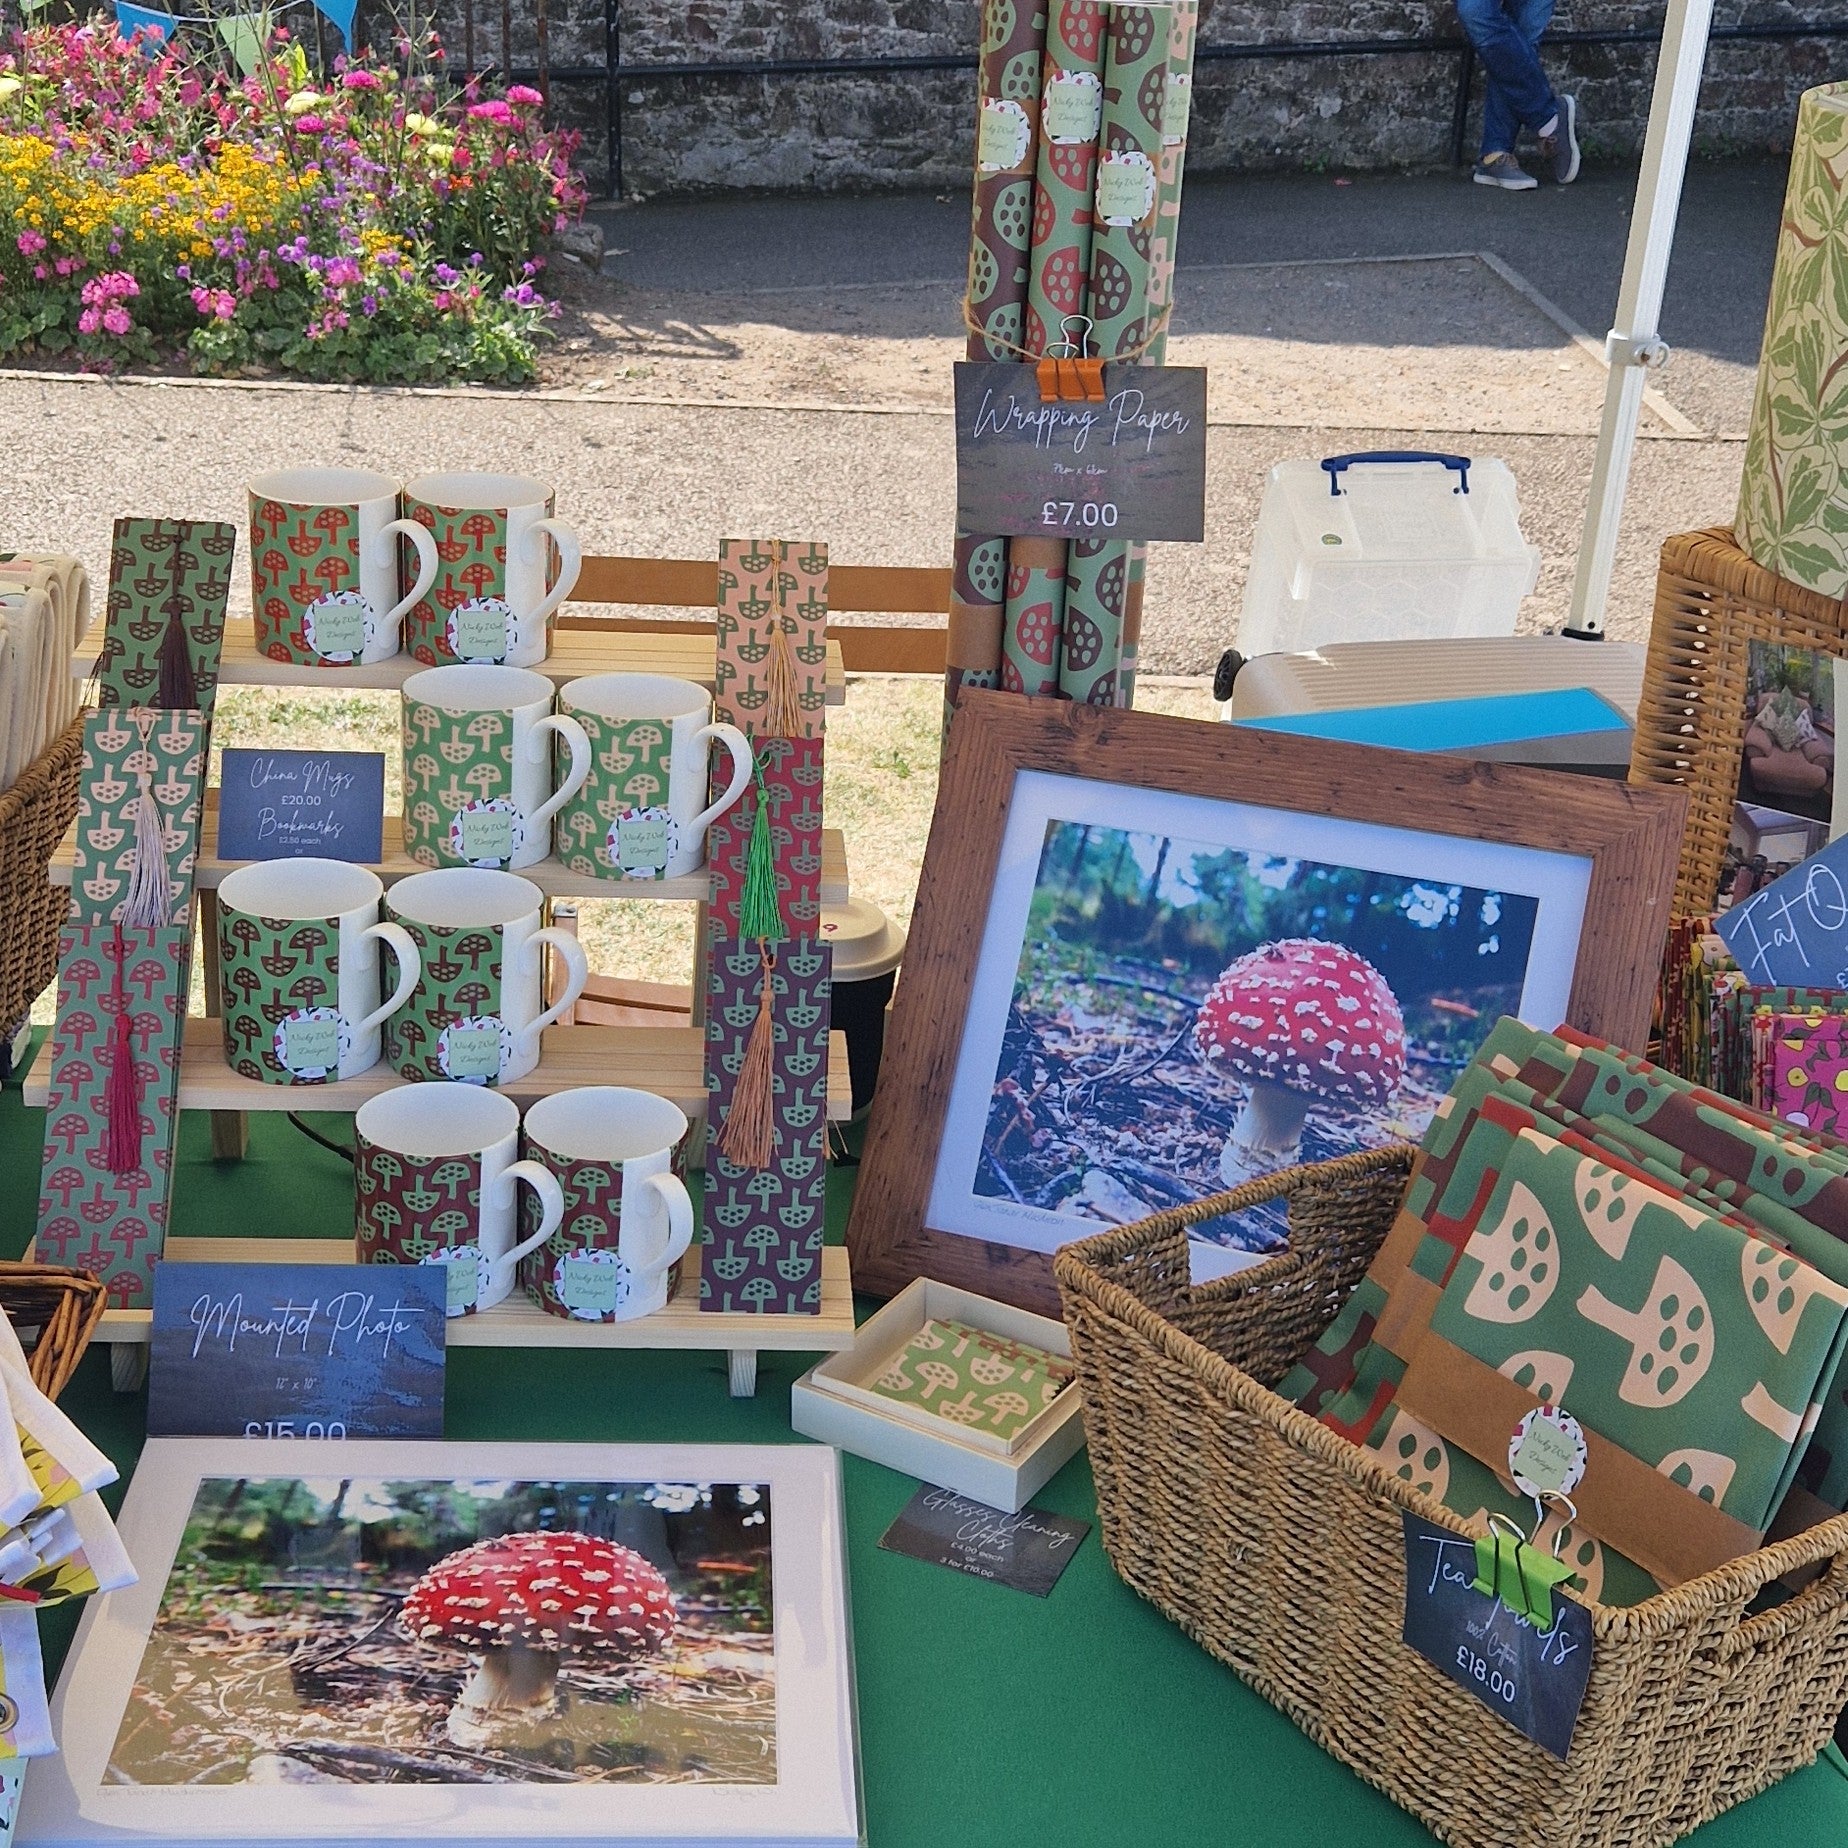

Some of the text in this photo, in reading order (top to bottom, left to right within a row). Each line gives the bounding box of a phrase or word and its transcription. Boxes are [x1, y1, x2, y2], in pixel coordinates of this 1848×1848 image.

[974, 388, 1191, 454] Wrapping Paper
[1041, 501, 1119, 527] £7.00
[250, 757, 355, 797] China Mugs
[281, 795, 322, 806] £20.00
[258, 807, 344, 840] Bookmarks
[1730, 887, 1817, 986] Fat
[190, 1291, 425, 1358] Mounted Photo
[292, 1381, 300, 1390] x
[242, 1421, 346, 1440] £1500
[923, 1488, 997, 1522] Glasses
[956, 1520, 1014, 1550] Cloths
[948, 1559, 963, 1568] for
[978, 1551, 1004, 1562] each
[1419, 1535, 1475, 1594] Tea
[1456, 1645, 1516, 1703] £18.00
